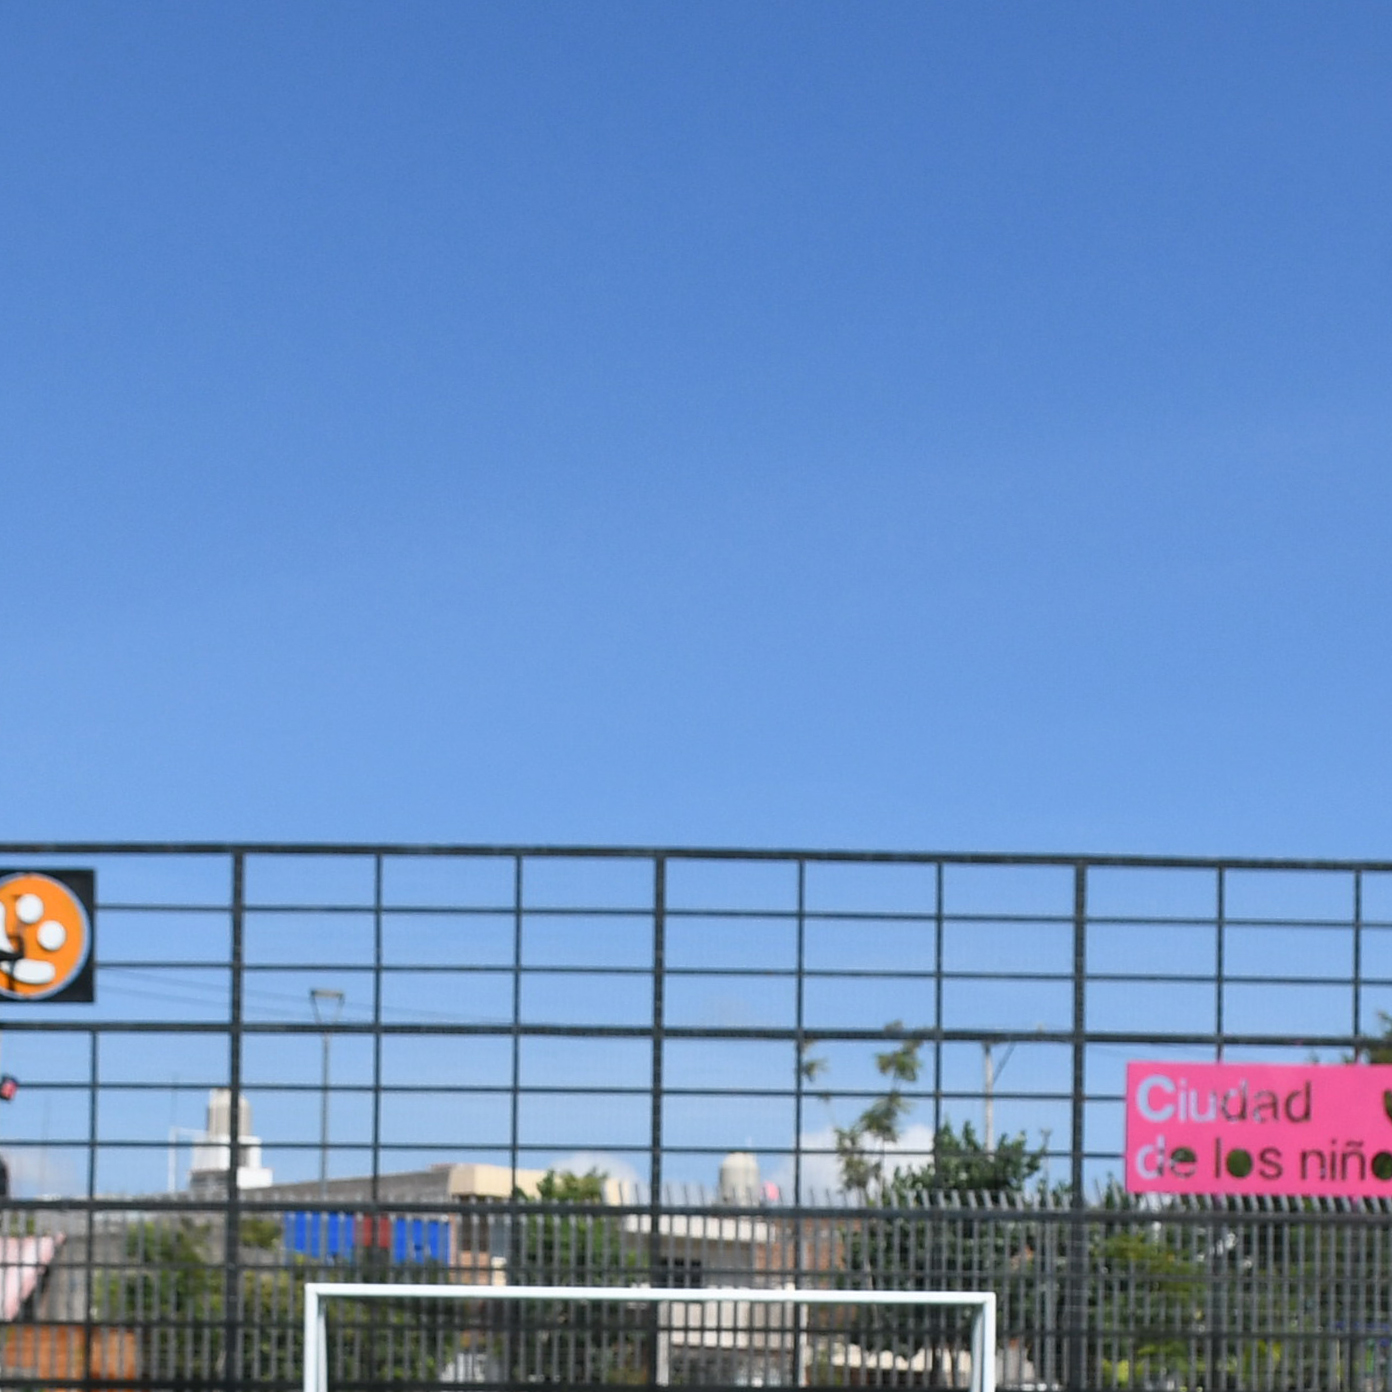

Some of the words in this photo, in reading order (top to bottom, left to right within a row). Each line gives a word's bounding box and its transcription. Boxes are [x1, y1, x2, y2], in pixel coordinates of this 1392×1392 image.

[1136, 1074, 1311, 1124] Ciudad
[1136, 1134, 1198, 1179] de
[1214, 1137, 1283, 1180] los
